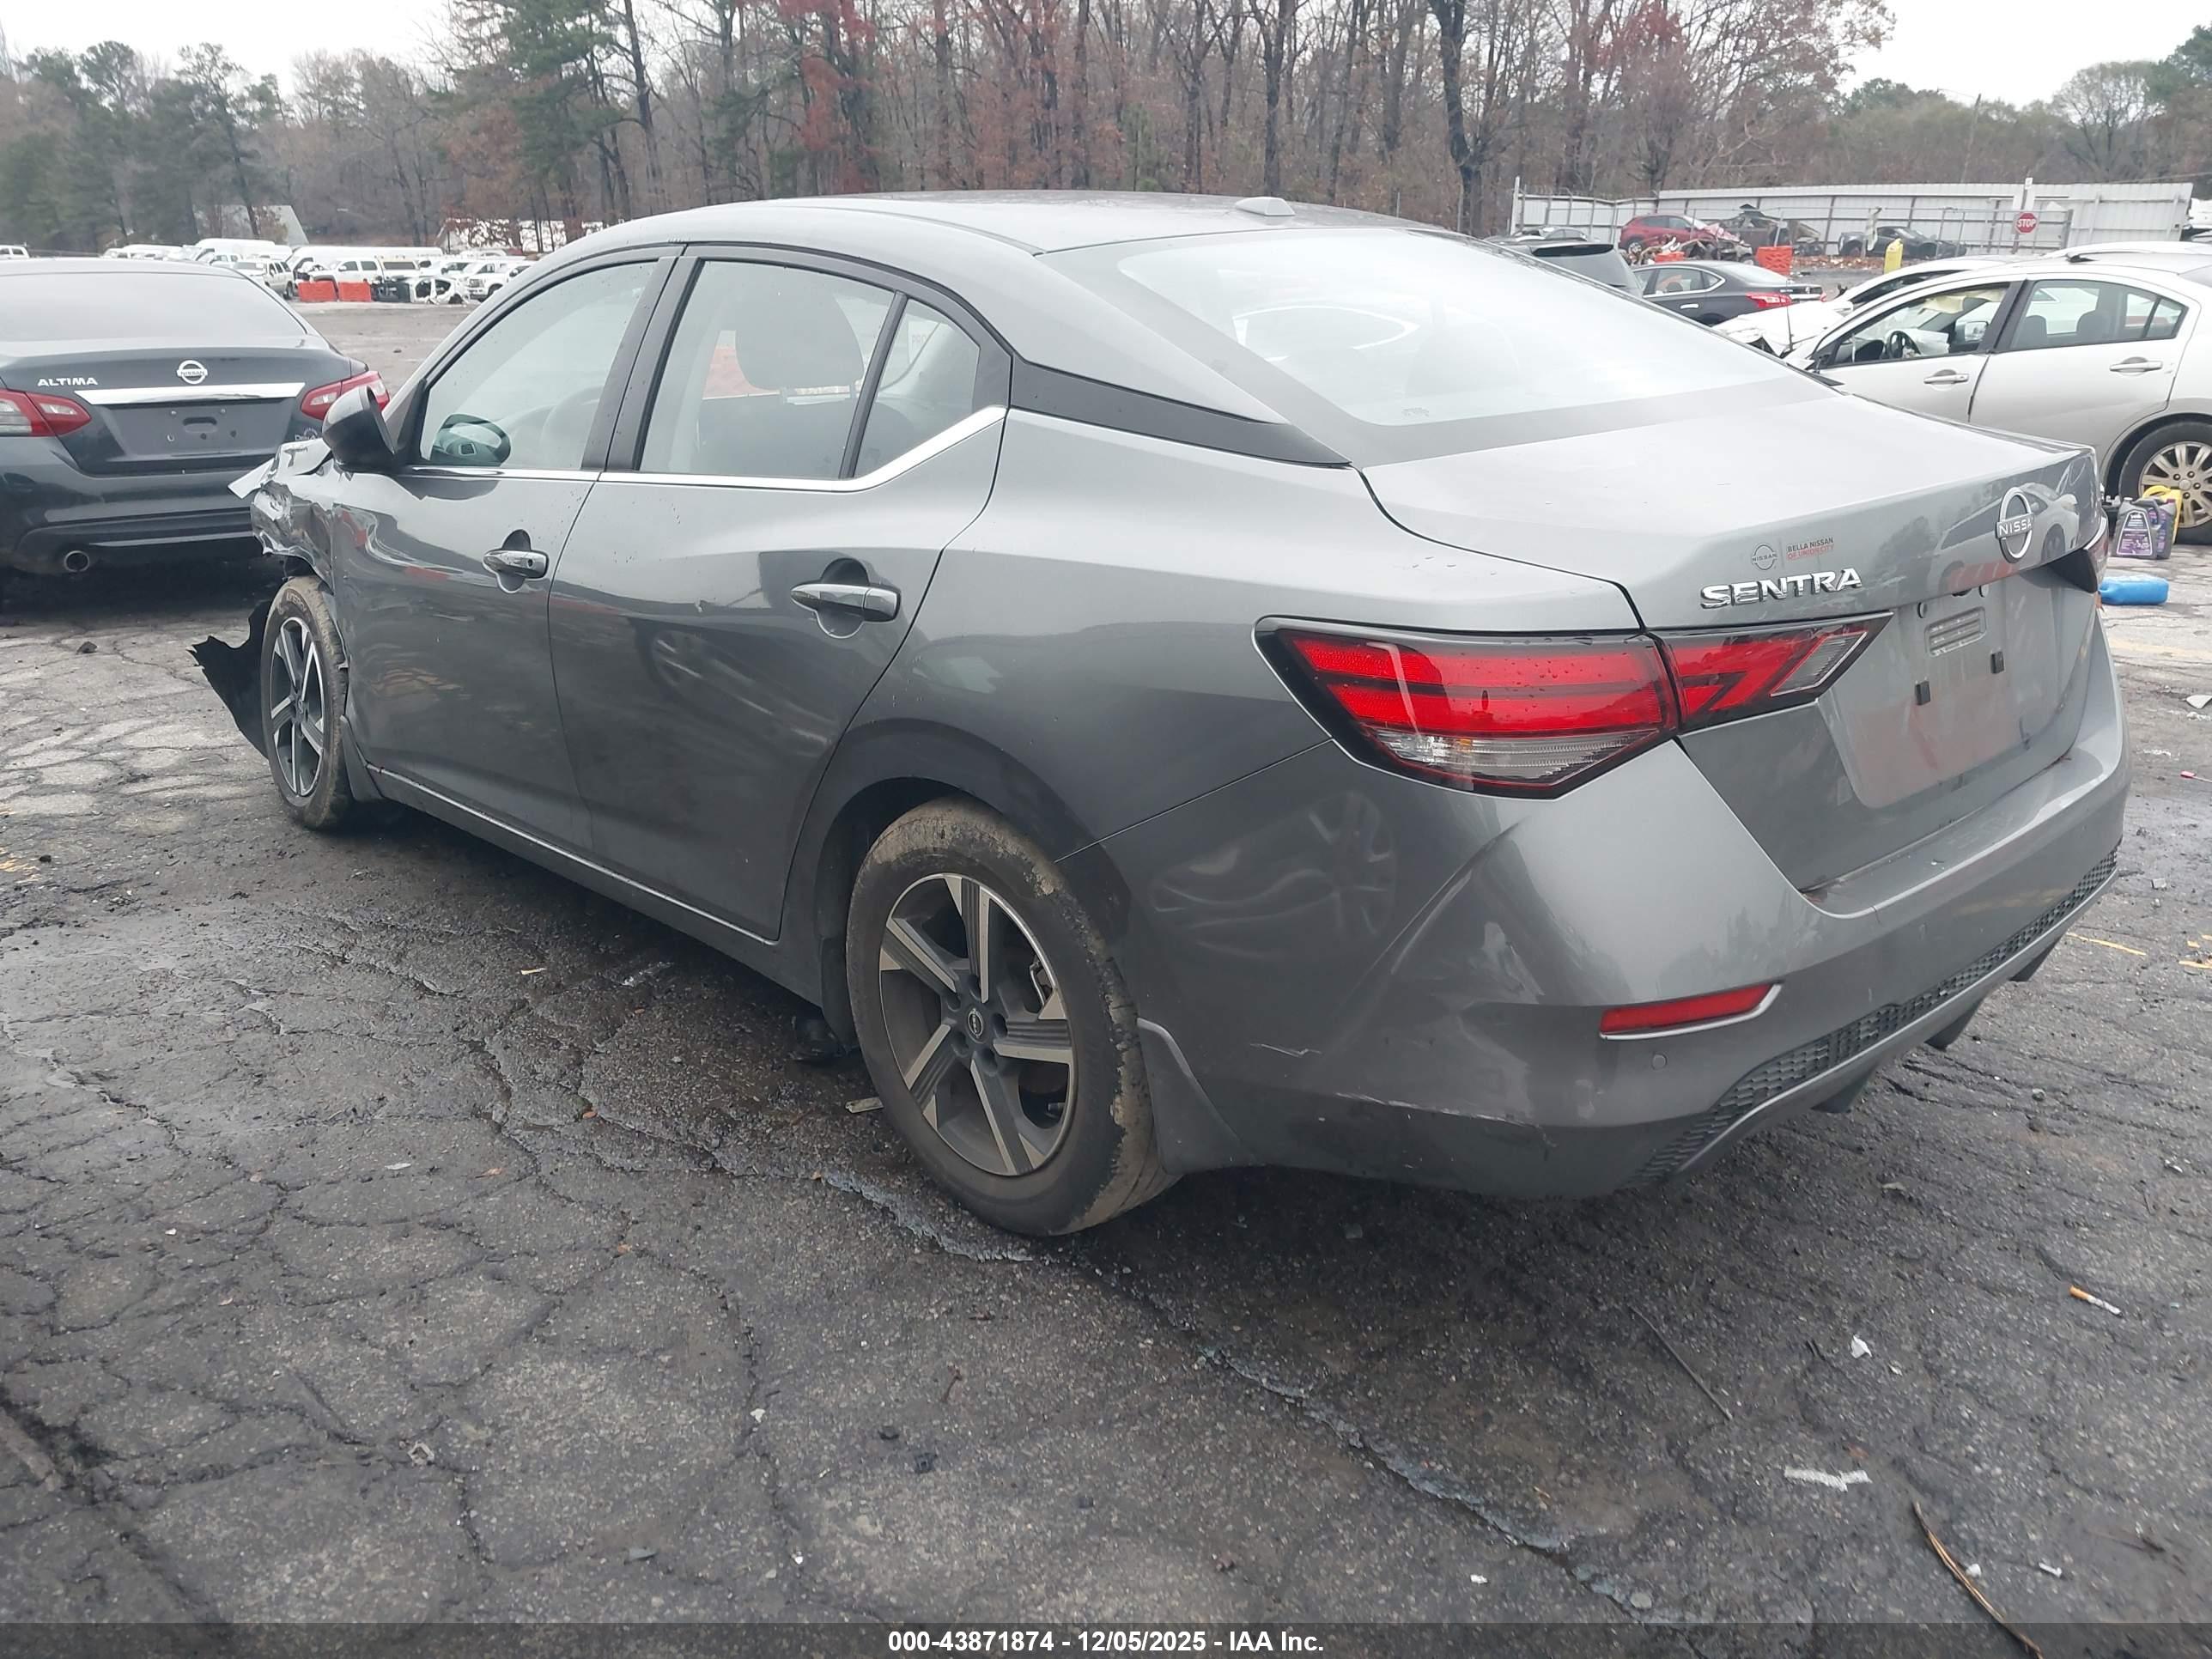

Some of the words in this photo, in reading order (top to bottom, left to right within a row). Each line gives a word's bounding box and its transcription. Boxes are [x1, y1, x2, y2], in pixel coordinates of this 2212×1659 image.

[2018, 219, 2036, 228] STOP
[37, 377, 99, 386] ALTIMA
[1998, 517, 2033, 536] NISSA
[1788, 543, 1808, 552] BELLA
[1809, 537, 1833, 549] NISSAN
[1752, 552, 1778, 562] NISSAN
[1700, 568, 1863, 609] SENTRA
